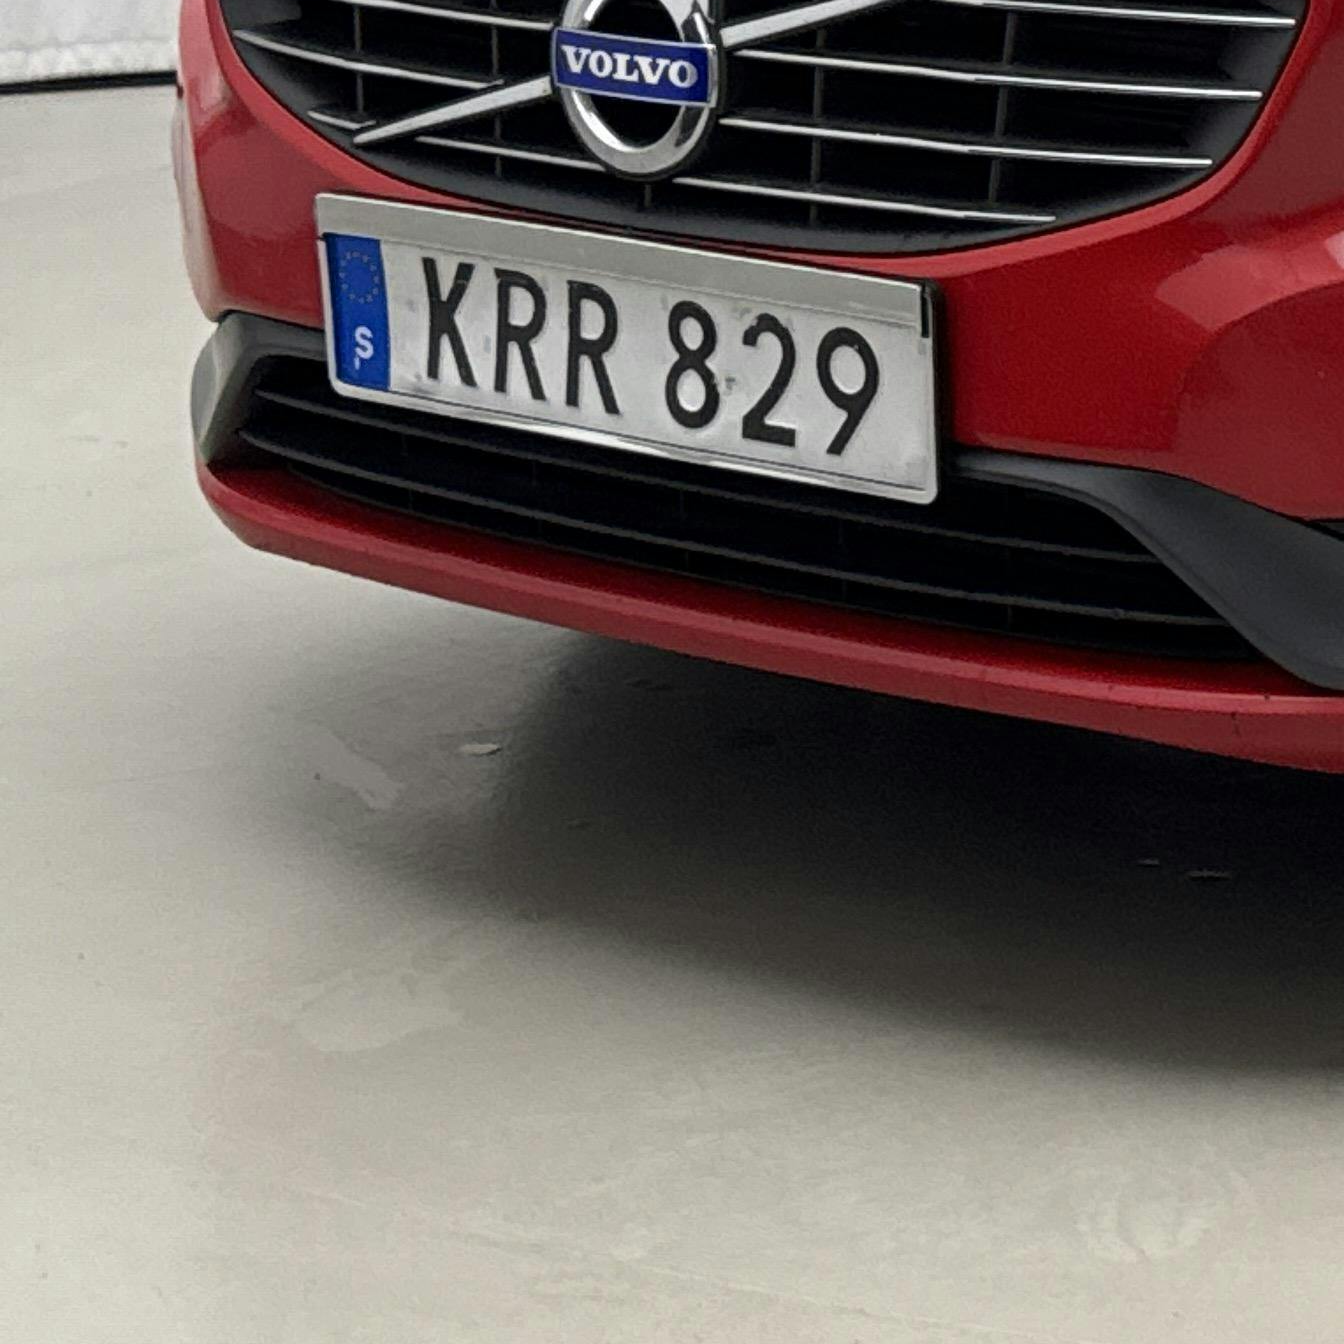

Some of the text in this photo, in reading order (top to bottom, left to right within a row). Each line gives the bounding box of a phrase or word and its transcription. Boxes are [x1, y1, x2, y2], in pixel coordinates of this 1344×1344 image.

[560, 44, 698, 89] VOLVO
[355, 326, 374, 360] S
[420, 256, 880, 456] KRR 829
